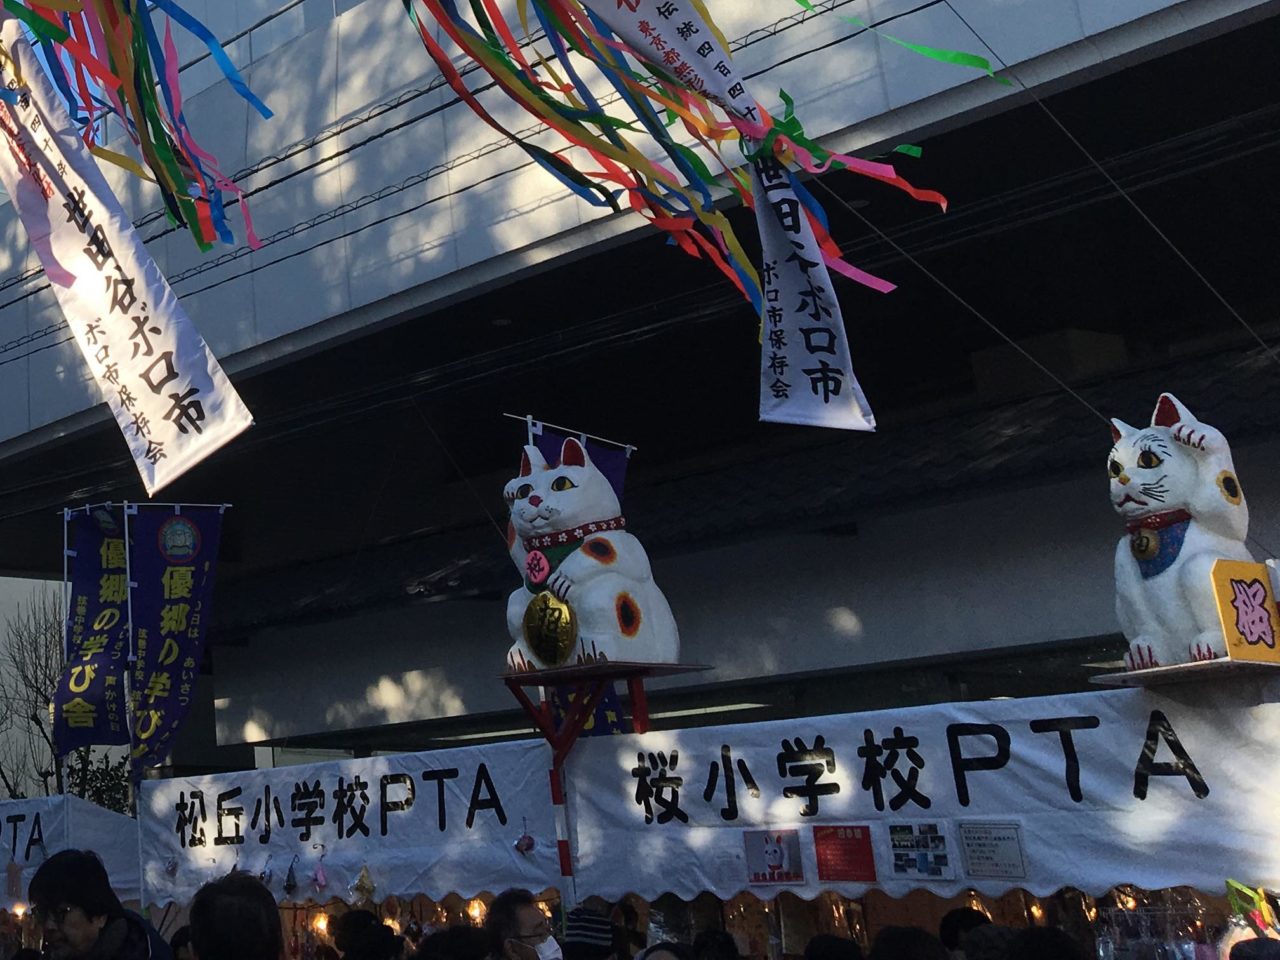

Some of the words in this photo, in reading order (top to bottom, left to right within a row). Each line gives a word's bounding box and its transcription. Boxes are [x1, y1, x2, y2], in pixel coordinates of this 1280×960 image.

[656, 1, 758, 142] 伝統四百四十
[63, 186, 206, 435] 世田谷ボロ市
[84, 317, 168, 466] ボロ市保存会
[175, 762, 508, 848] 松丘小学校PTA
[630, 709, 1210, 825] 桜小学校PTA
